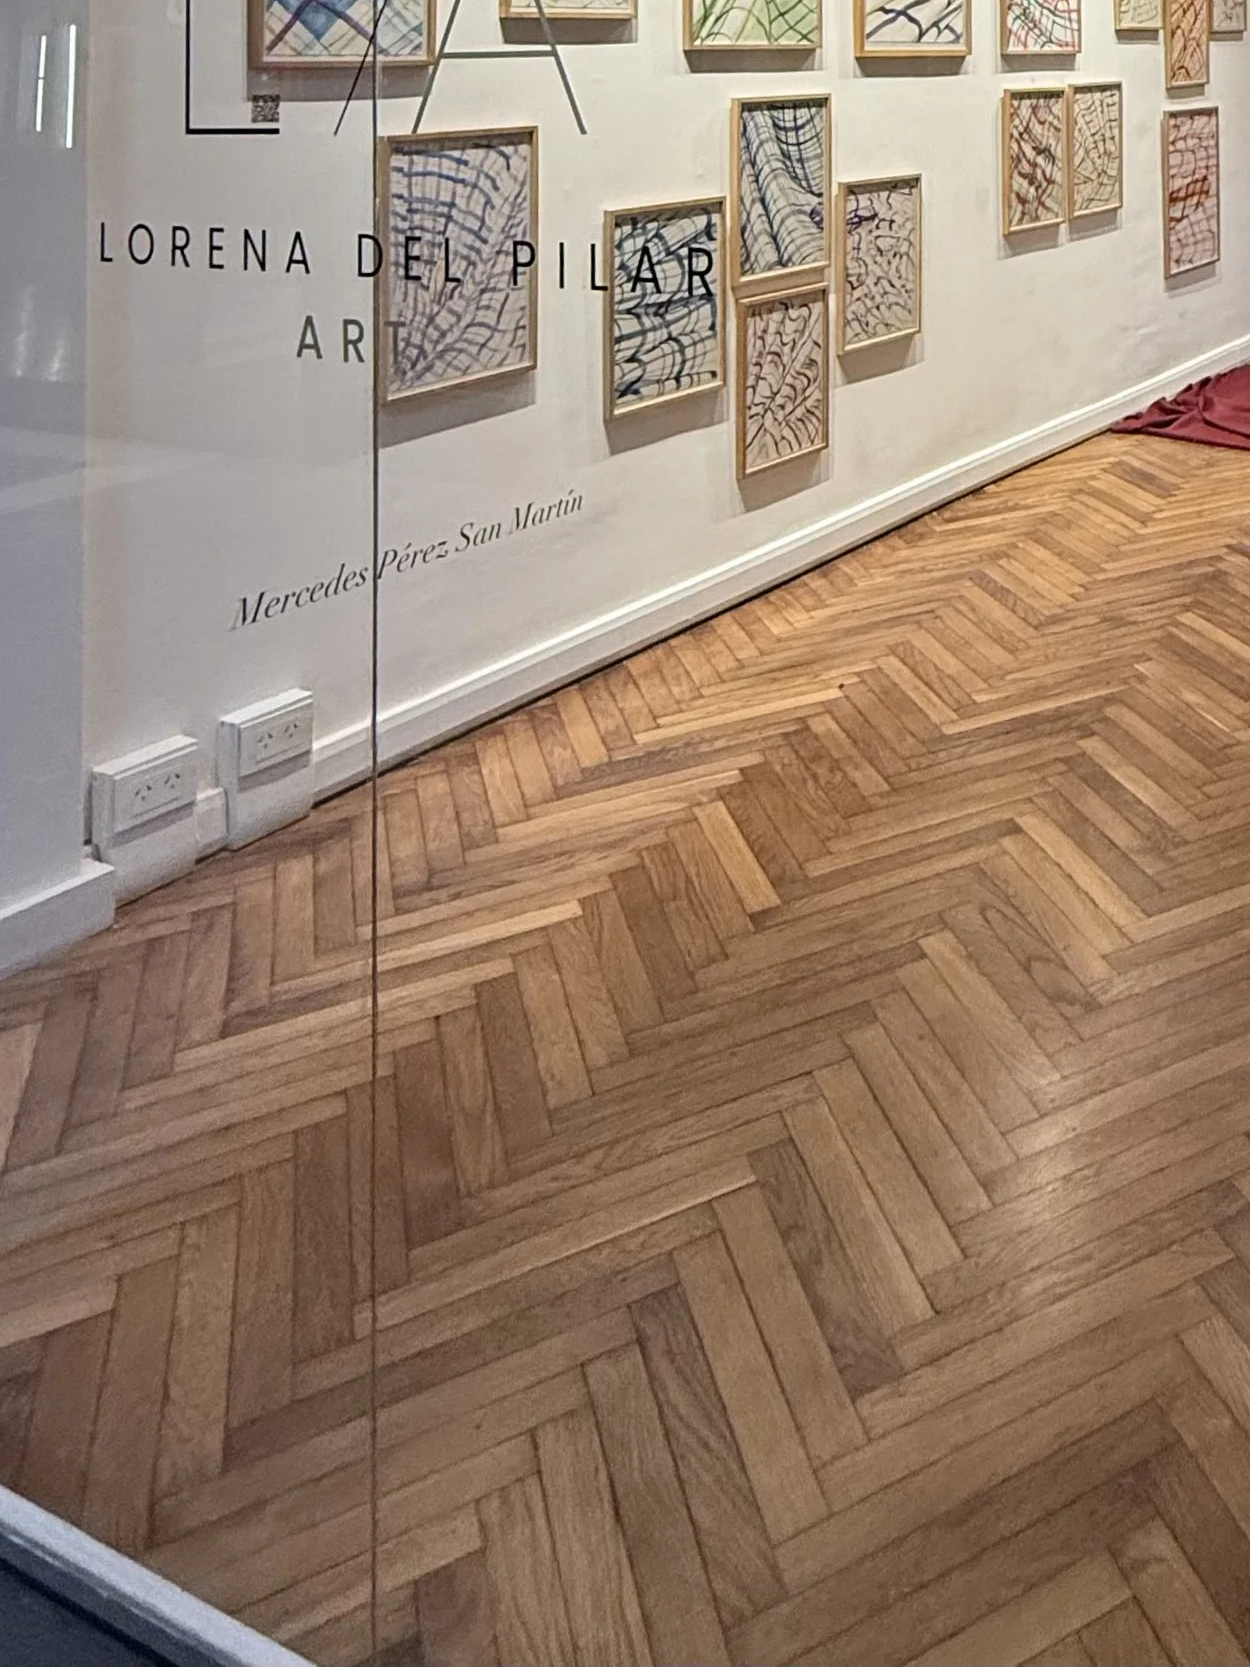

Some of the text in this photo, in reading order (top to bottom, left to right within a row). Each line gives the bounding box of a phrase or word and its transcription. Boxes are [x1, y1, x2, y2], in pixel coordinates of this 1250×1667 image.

[99, 221, 714, 298] LORENA DEL PILAR
[229, 488, 584, 632] Mercedes Pérez San Martín
